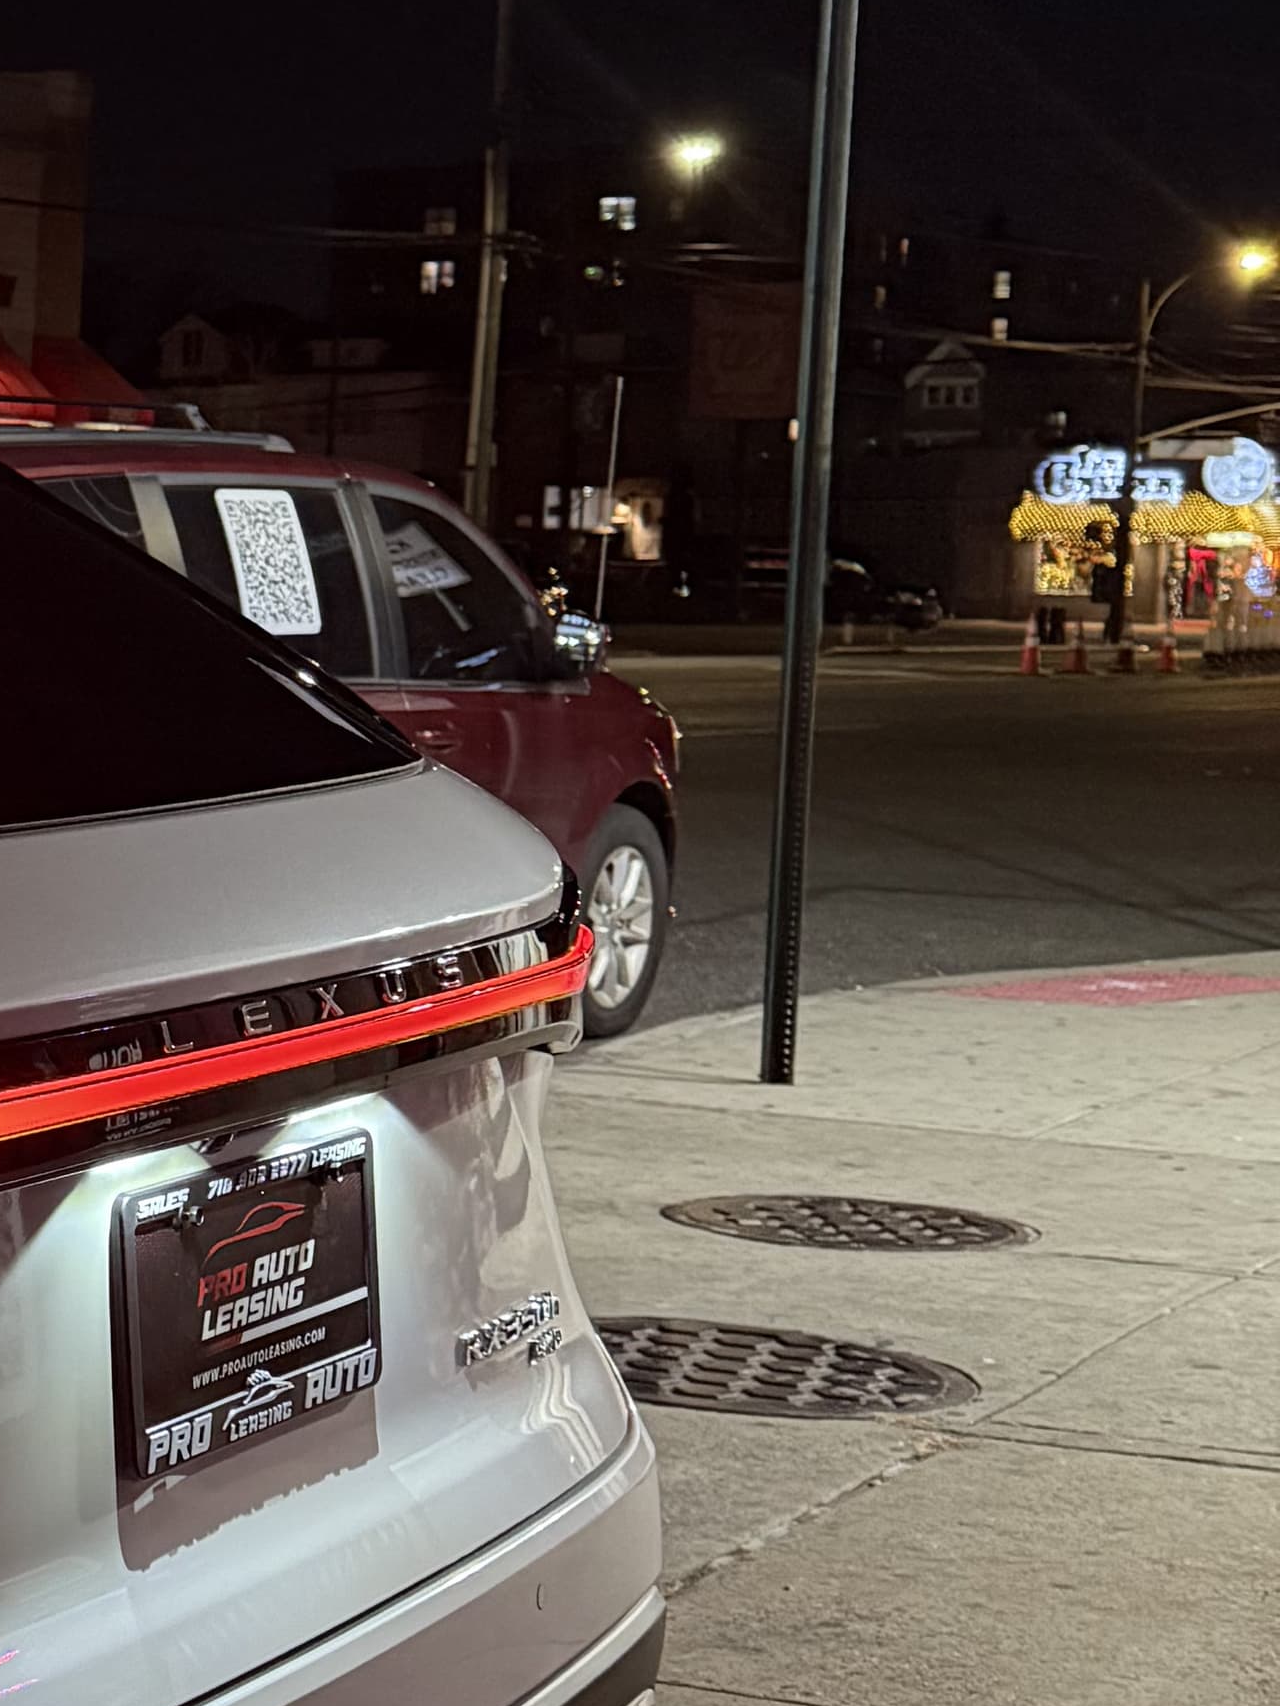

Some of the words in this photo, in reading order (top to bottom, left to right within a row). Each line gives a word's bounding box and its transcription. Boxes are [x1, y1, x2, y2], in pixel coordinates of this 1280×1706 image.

[159, 956, 463, 1056] LEXUS
[311, 1136, 367, 1169] LEASING
[197, 1262, 248, 1308] PRO
[252, 1238, 316, 1288] AUTO
[201, 1276, 305, 1342] LEASING
[192, 1326, 327, 1390] WWW.PROAUTOLEASING.COM
[147, 1411, 214, 1476] PRO
[229, 1400, 294, 1442] LEASING
[304, 1347, 378, 1411] AUTO
